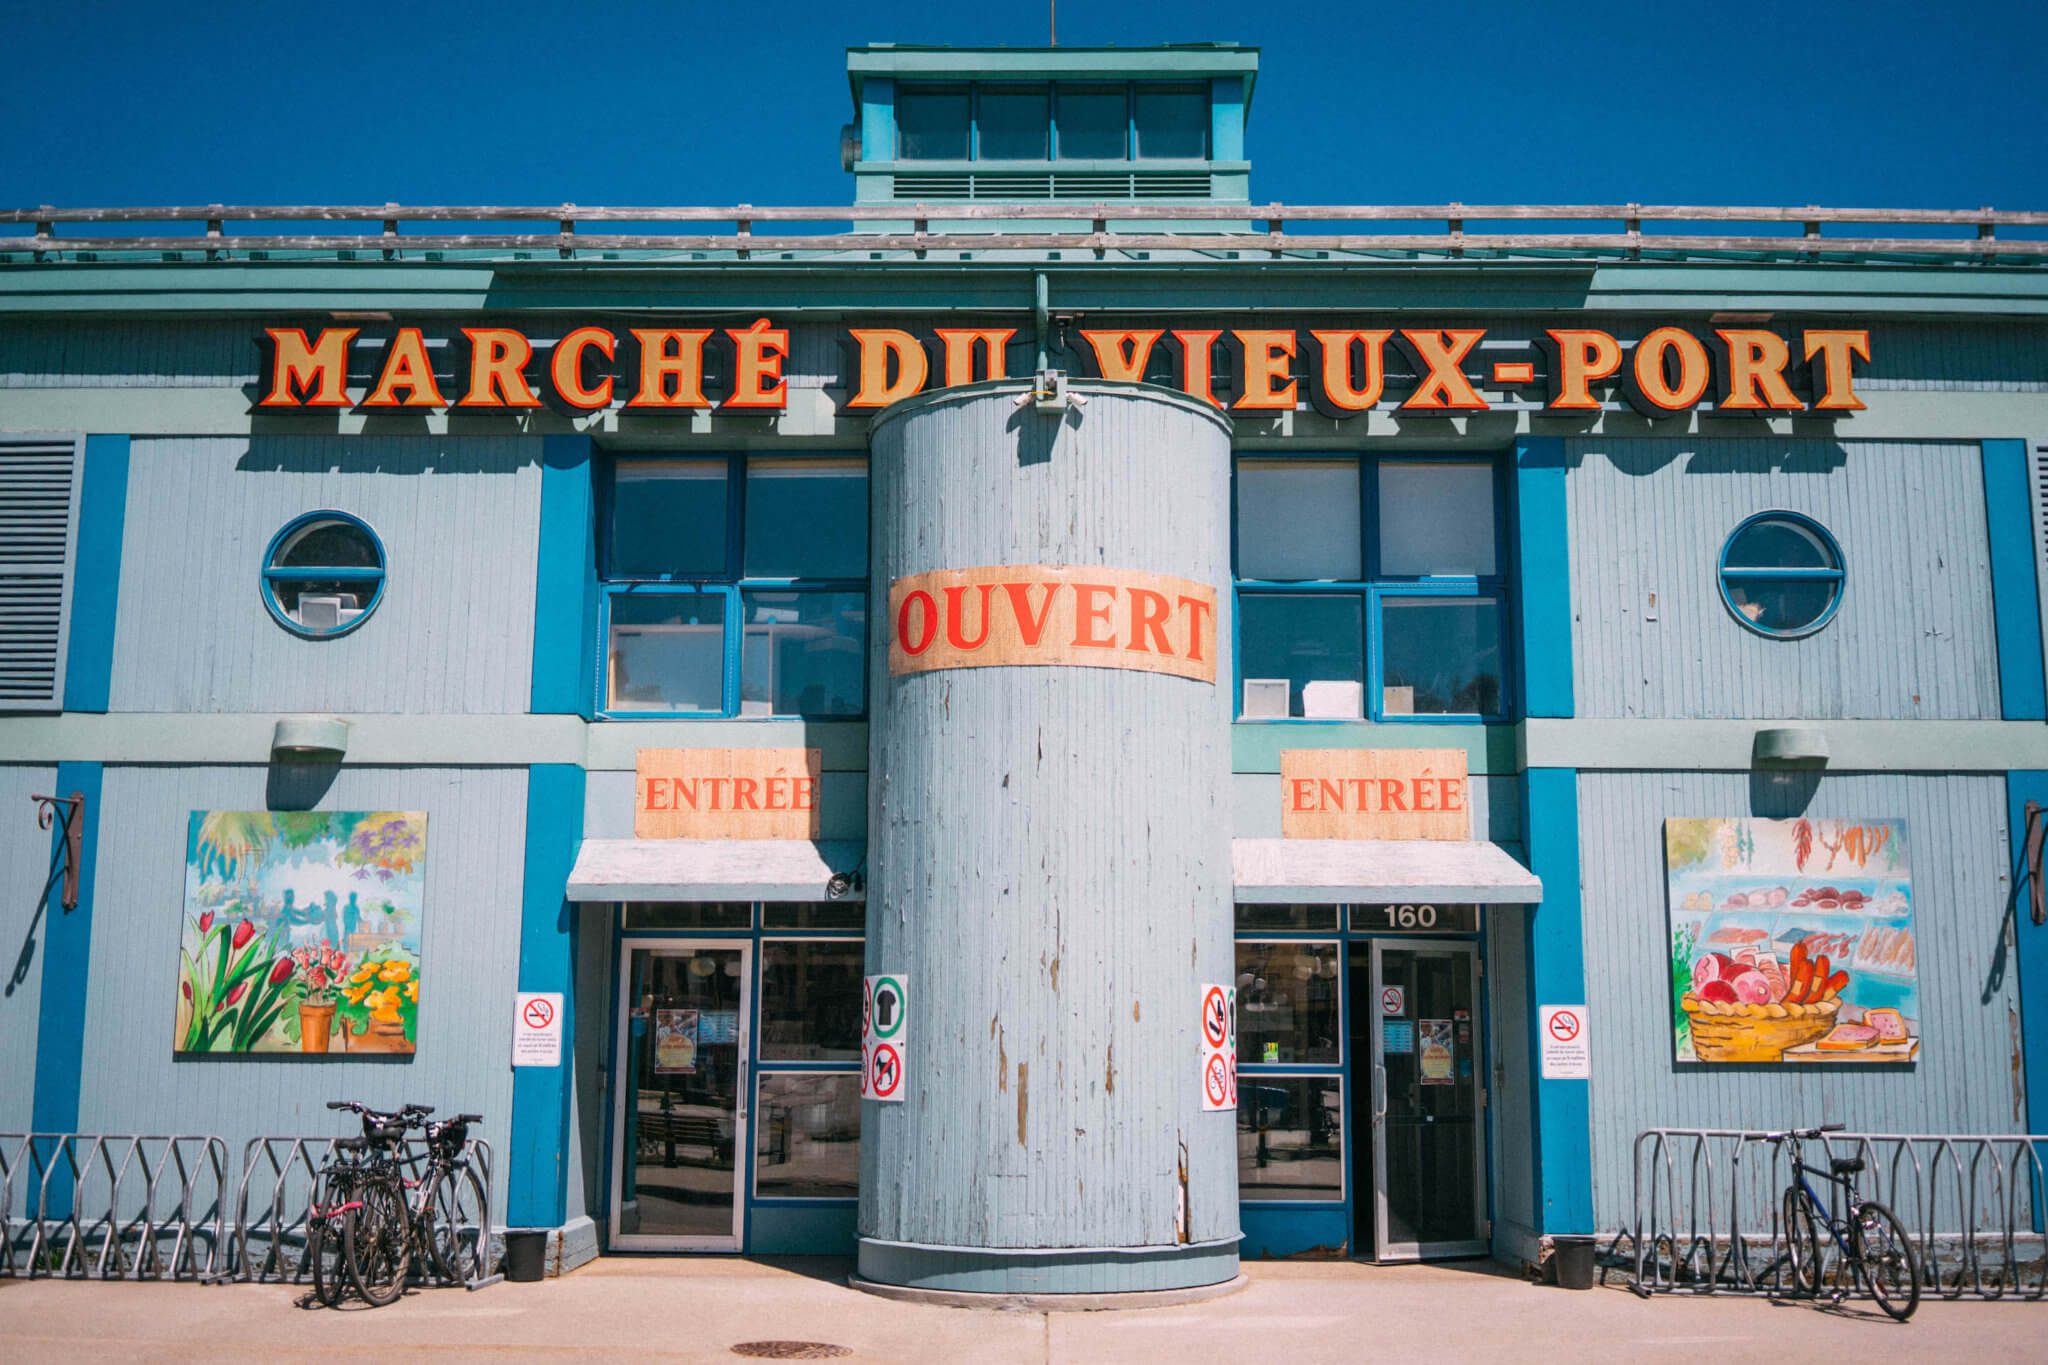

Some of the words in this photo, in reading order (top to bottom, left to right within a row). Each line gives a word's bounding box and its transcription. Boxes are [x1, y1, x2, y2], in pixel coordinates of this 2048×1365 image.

[260, 318, 789, 409] MARCHÉ
[847, 328, 1017, 407] DU
[1079, 326, 1870, 409] VIEUX-PORT
[898, 582, 1210, 661] OUVERT
[645, 767, 814, 810] ENTRÉE
[1291, 768, 1462, 811] ENTRÉE
[1384, 904, 1437, 928] 160
